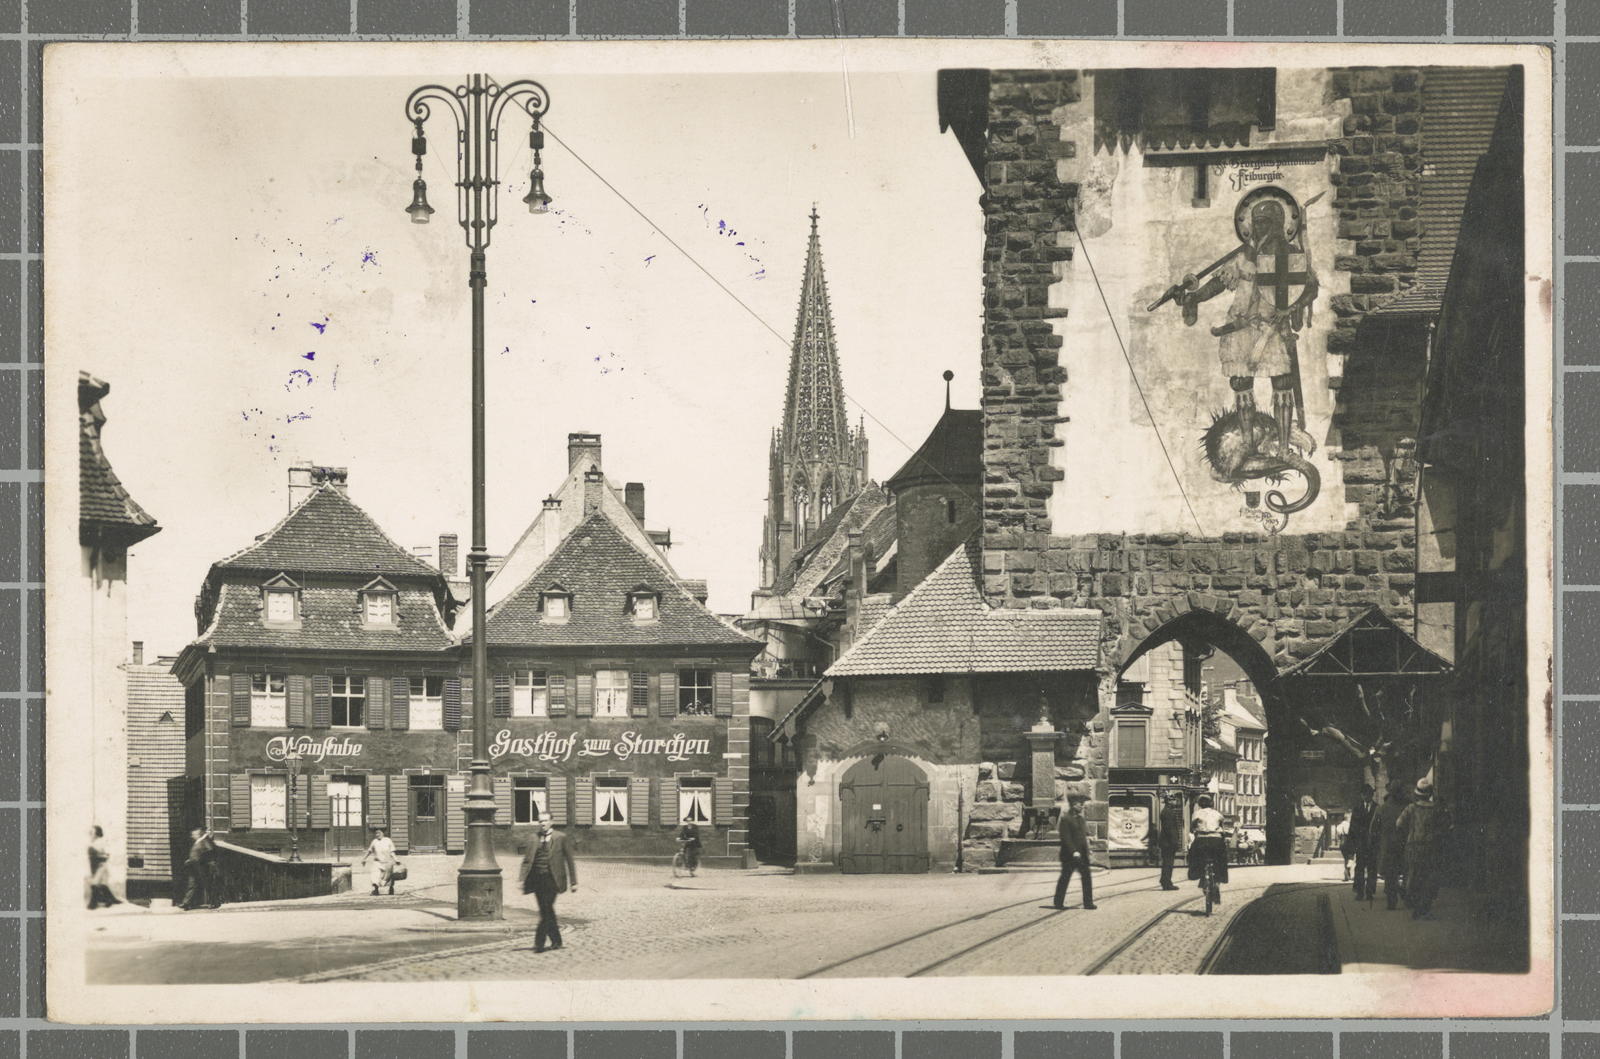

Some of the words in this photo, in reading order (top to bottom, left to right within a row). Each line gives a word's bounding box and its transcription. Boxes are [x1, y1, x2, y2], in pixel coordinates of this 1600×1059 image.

[488, 729, 578, 762] Gasthof
[577, 738, 611, 757] zum
[613, 730, 711, 761] Storchen
